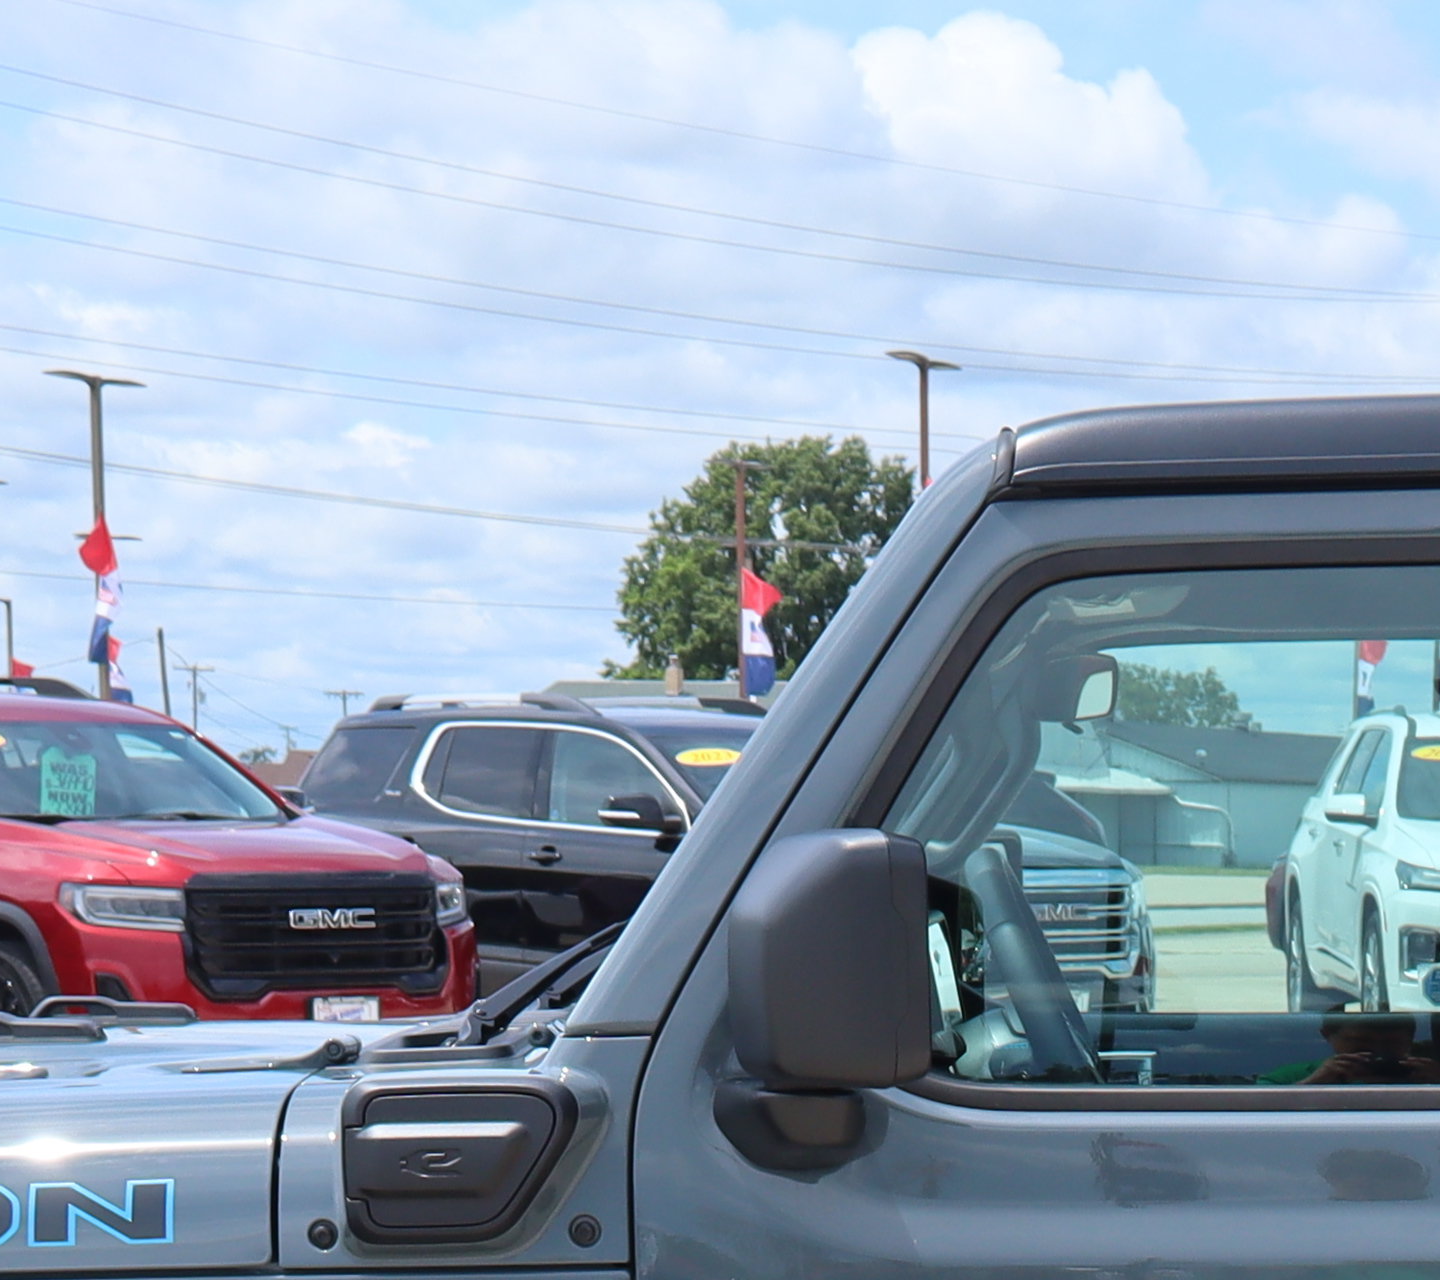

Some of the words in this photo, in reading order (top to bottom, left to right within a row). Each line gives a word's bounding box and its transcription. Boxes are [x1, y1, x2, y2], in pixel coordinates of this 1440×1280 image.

[49, 762, 88, 776] WAS
[48, 790, 88, 803] NOW
[288, 908, 377, 930] GMC
